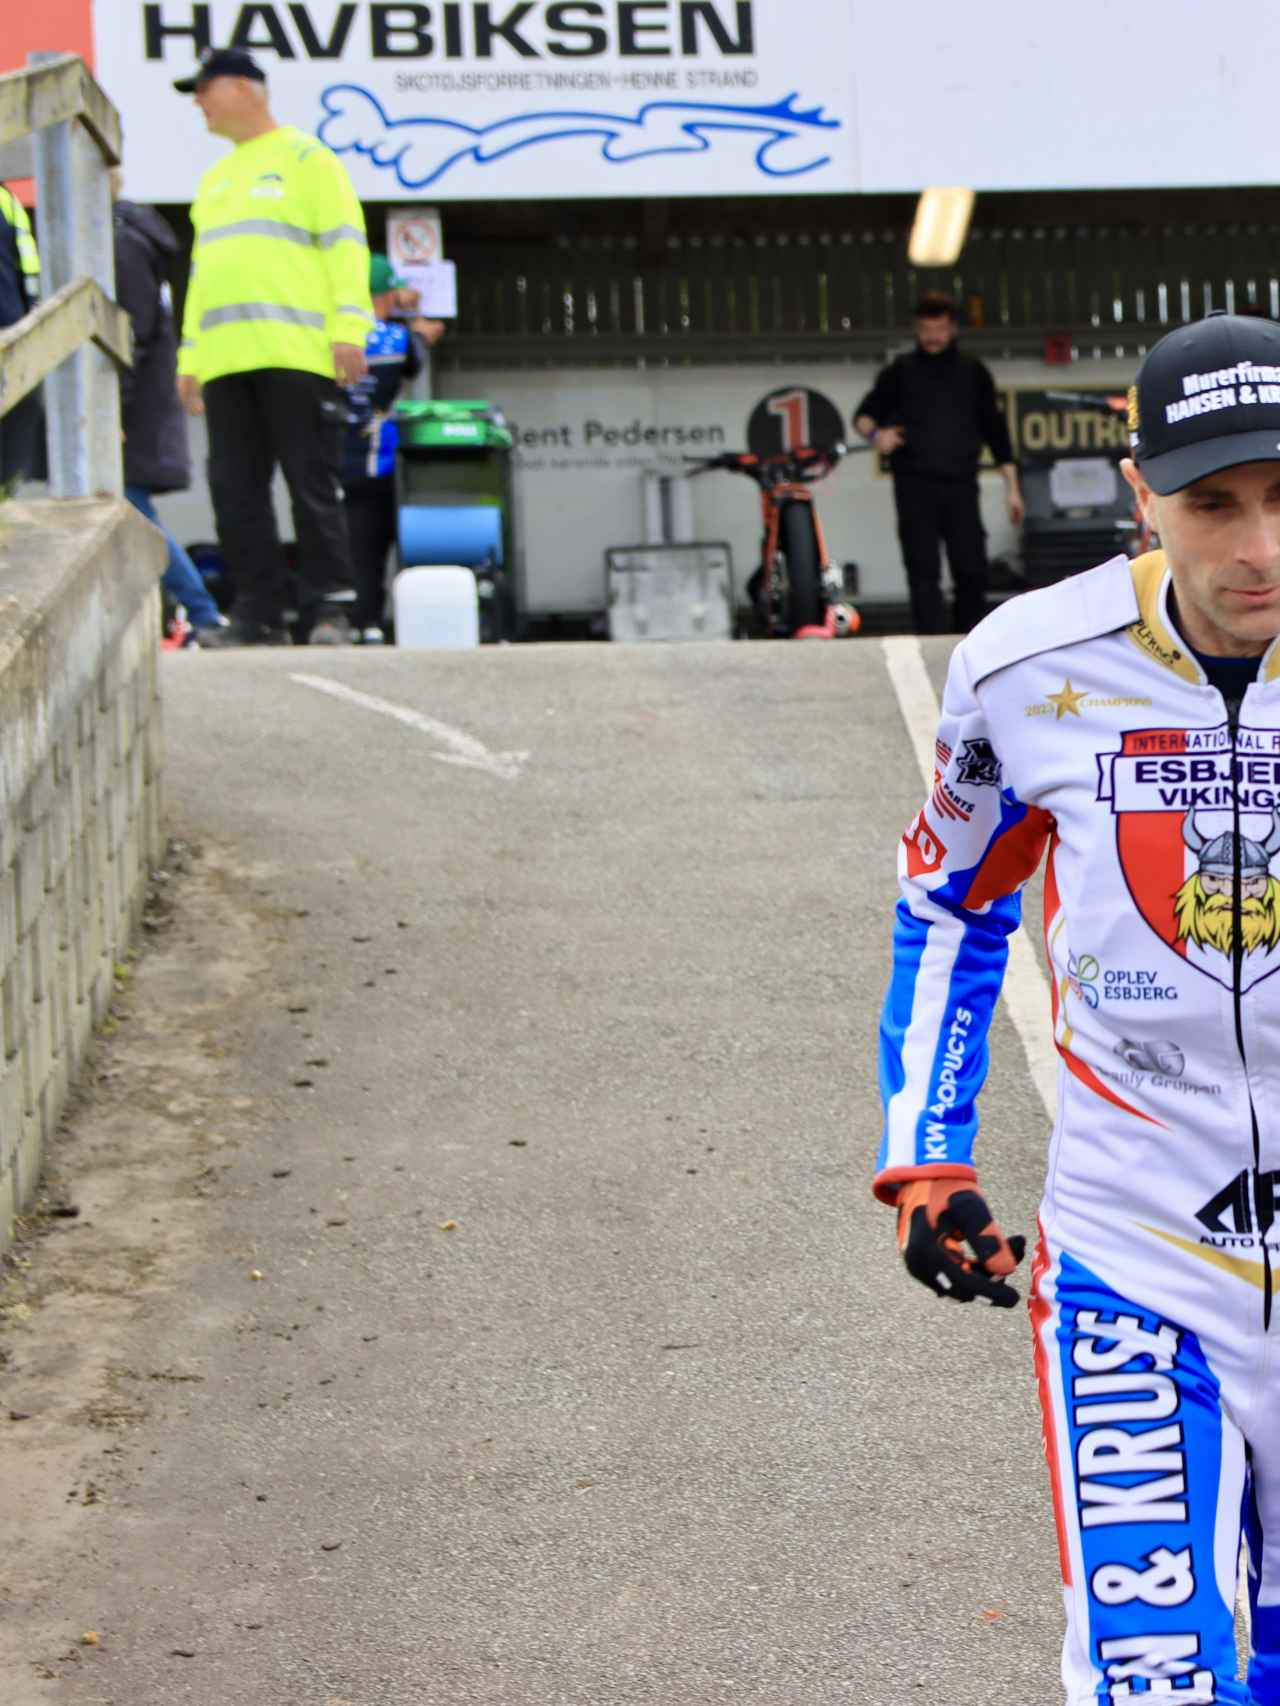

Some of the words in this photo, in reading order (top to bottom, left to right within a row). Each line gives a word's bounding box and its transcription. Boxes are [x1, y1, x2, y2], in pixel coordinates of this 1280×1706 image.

[143, 2, 755, 59] HAVBIKSEN
[1165, 387, 1238, 424] HANSEN
[1238, 385, 1258, 404] &
[583, 420, 726, 447] Pedersen
[1133, 730, 1264, 751] INTERNATIONAL
[1104, 969, 1158, 986] OPLEV
[1104, 986, 1179, 1001] ESBJERG
[1199, 1235, 1255, 1248] AUTO
[1072, 1309, 1190, 1531] KRUSE
[1091, 1542, 1198, 1608] &
